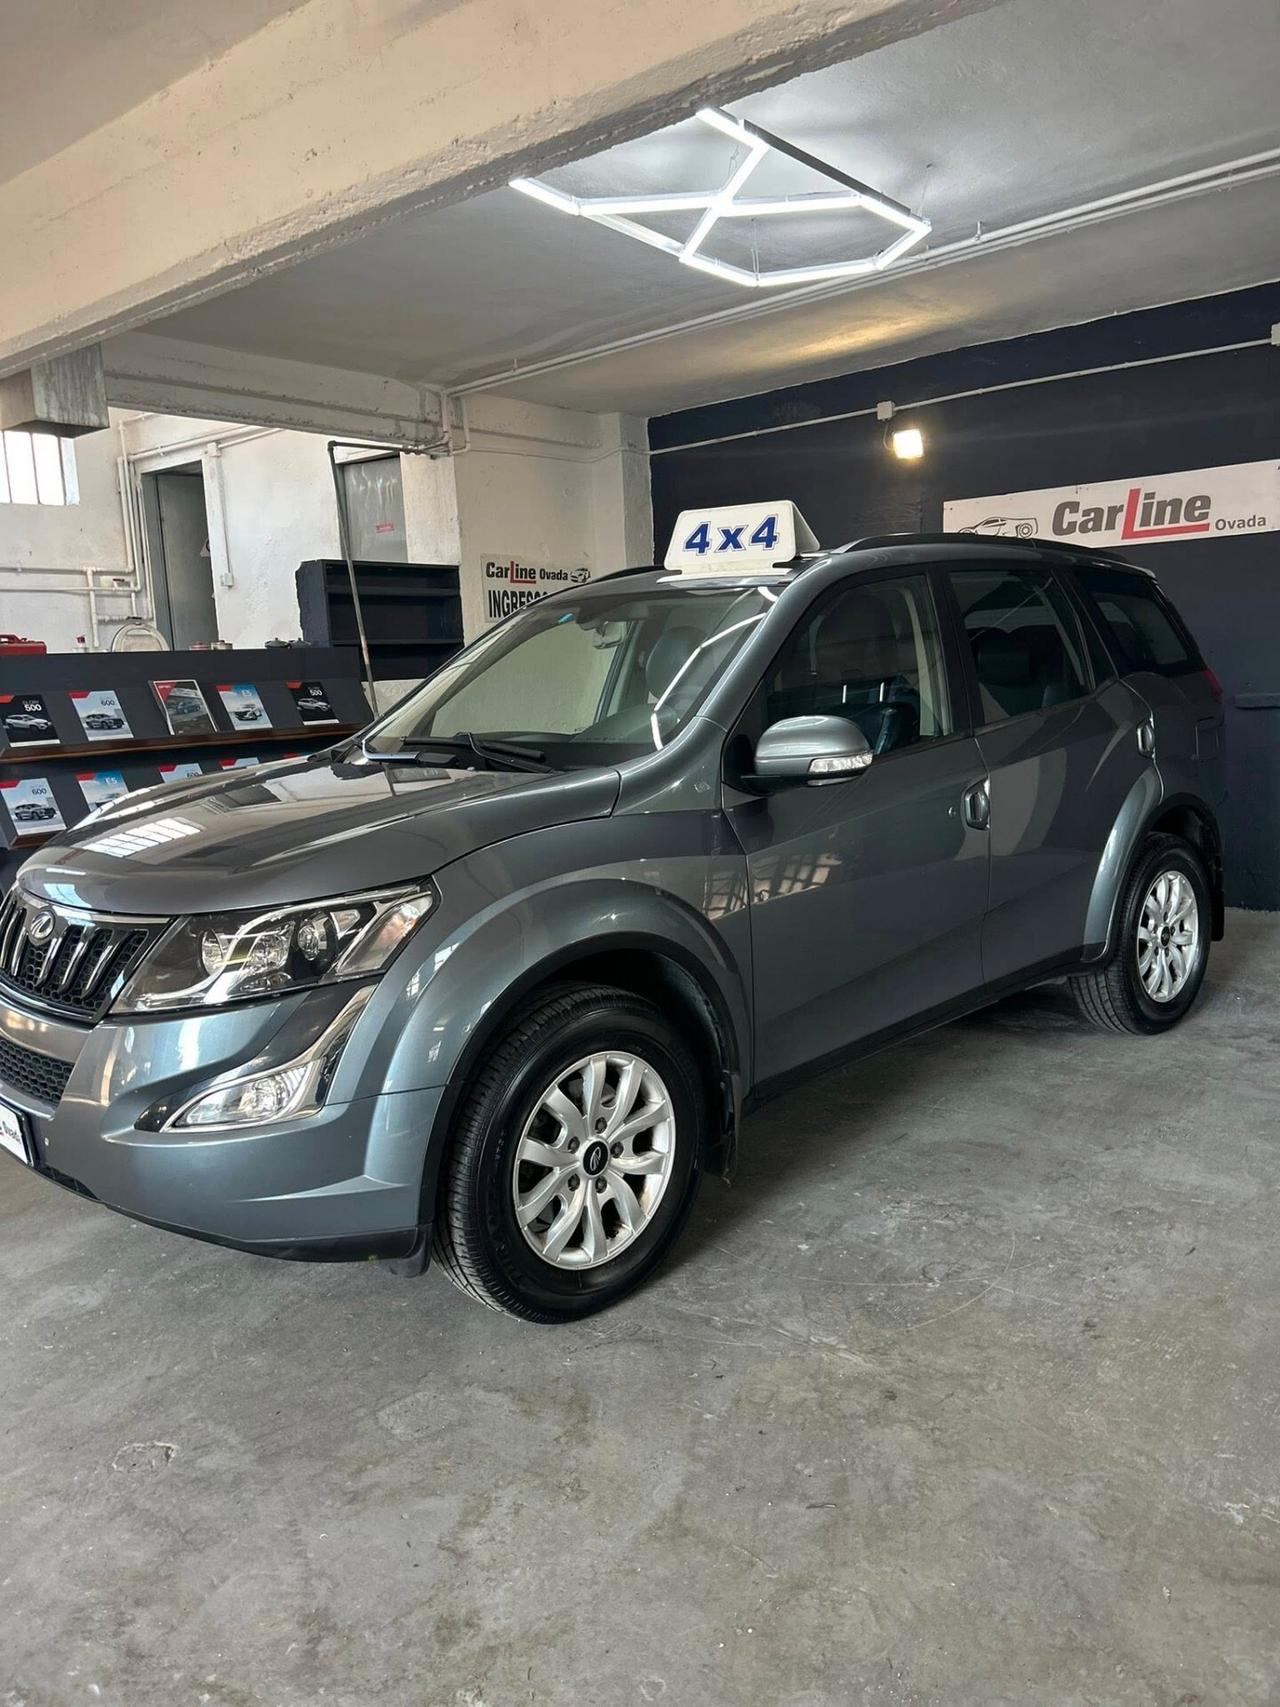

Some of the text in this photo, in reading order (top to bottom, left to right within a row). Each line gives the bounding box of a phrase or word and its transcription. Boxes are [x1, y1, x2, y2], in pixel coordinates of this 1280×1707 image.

[1051, 488, 1267, 540] CarLine Ovada
[486, 561, 569, 584] CarLine Ovada
[24, 703, 42, 712] 500
[31, 787, 48, 795] 600
